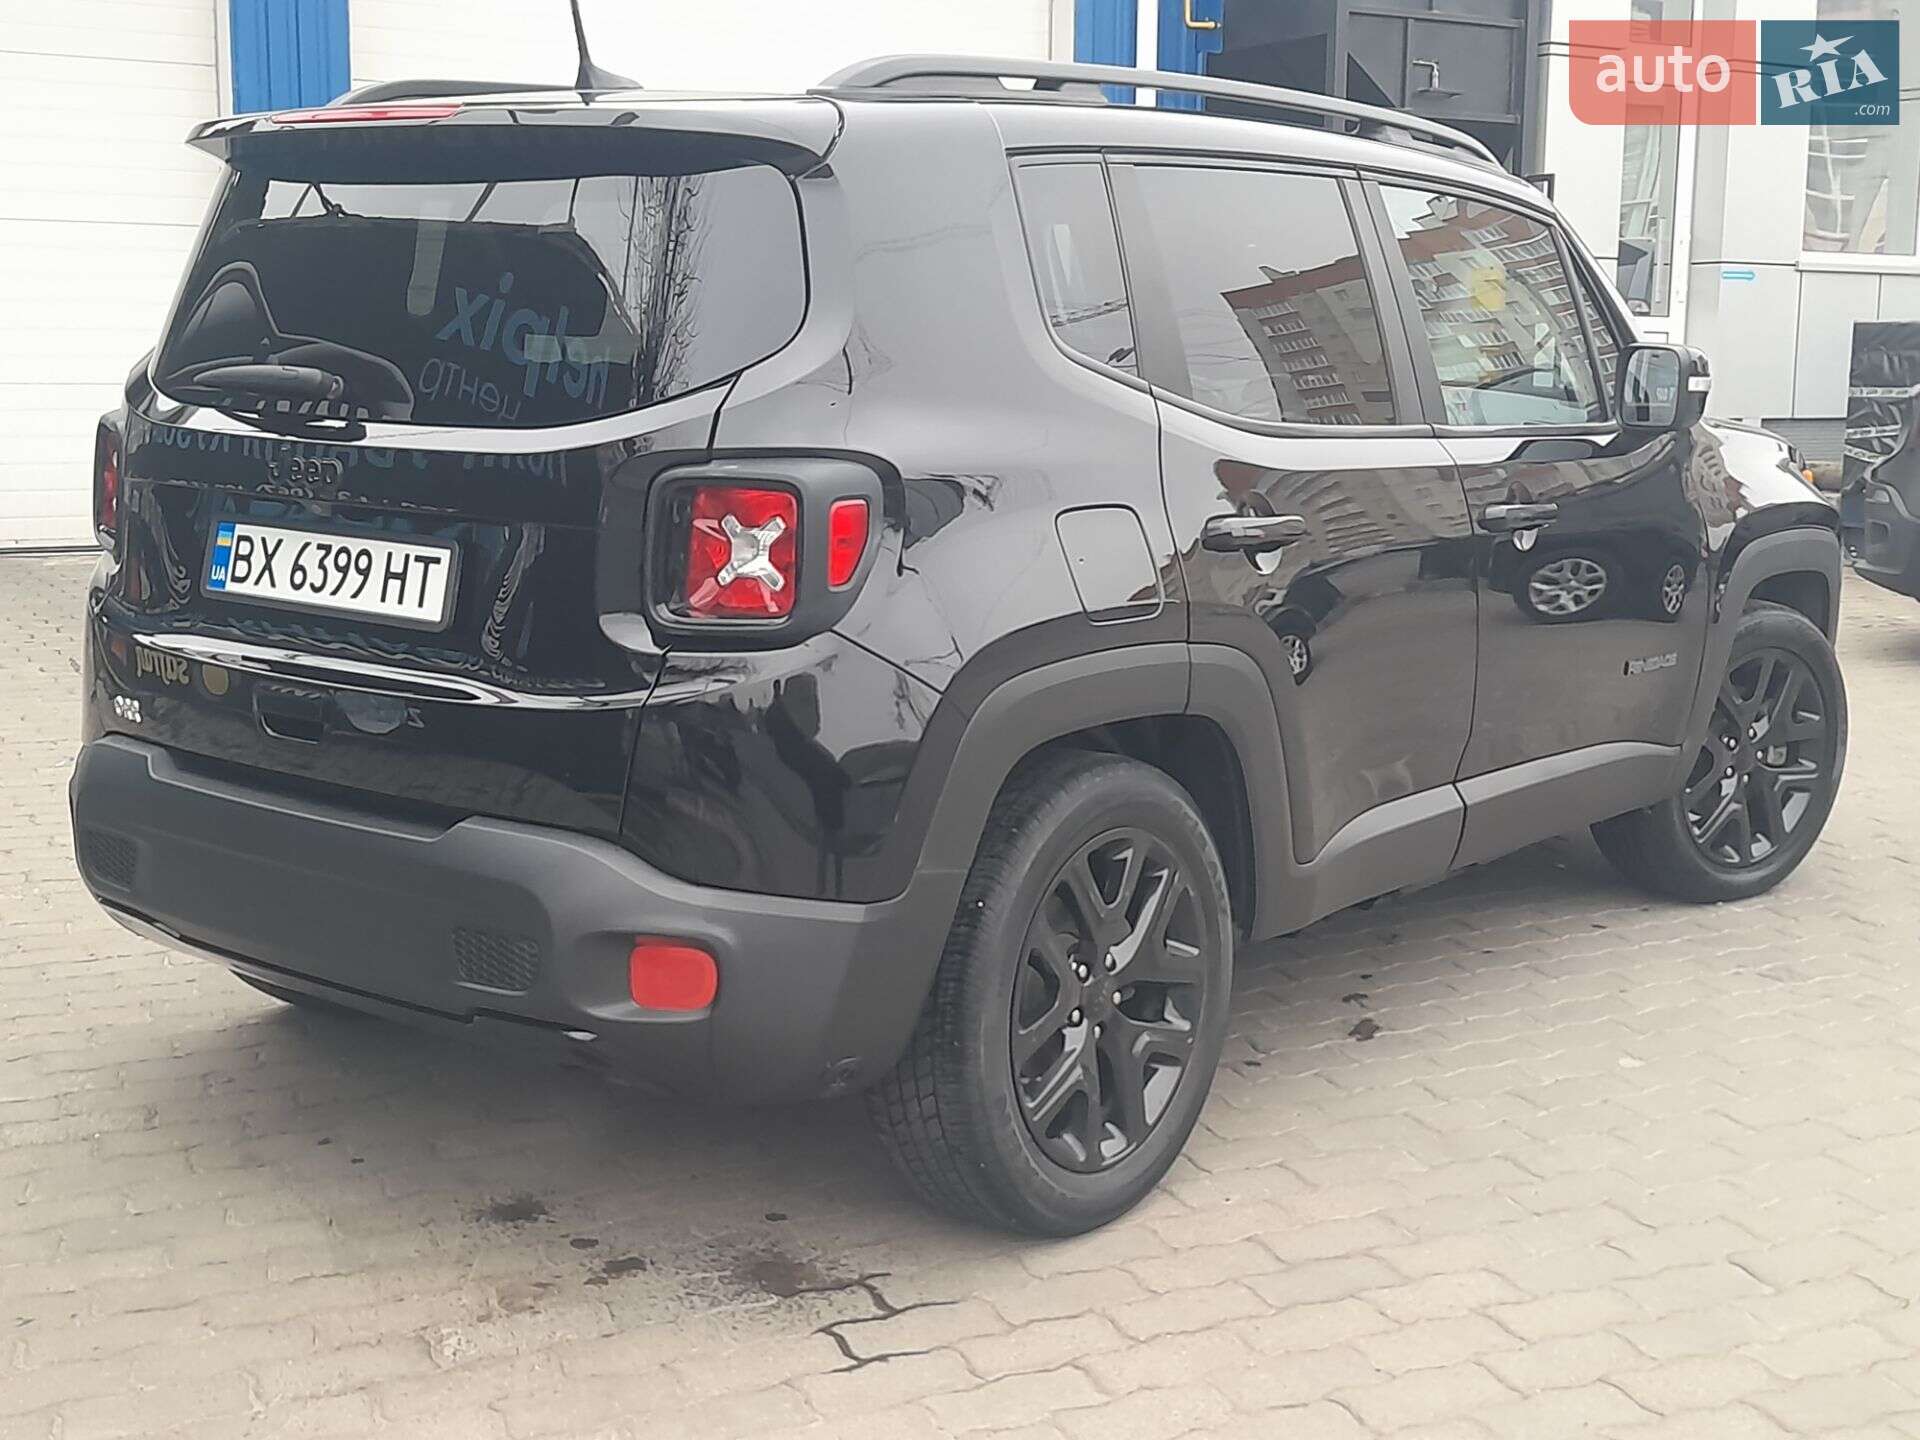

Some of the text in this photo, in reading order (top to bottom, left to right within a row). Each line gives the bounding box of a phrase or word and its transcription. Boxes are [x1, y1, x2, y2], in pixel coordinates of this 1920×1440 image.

[211, 564, 226, 581] UA
[230, 534, 442, 608] BX 6399 HT
